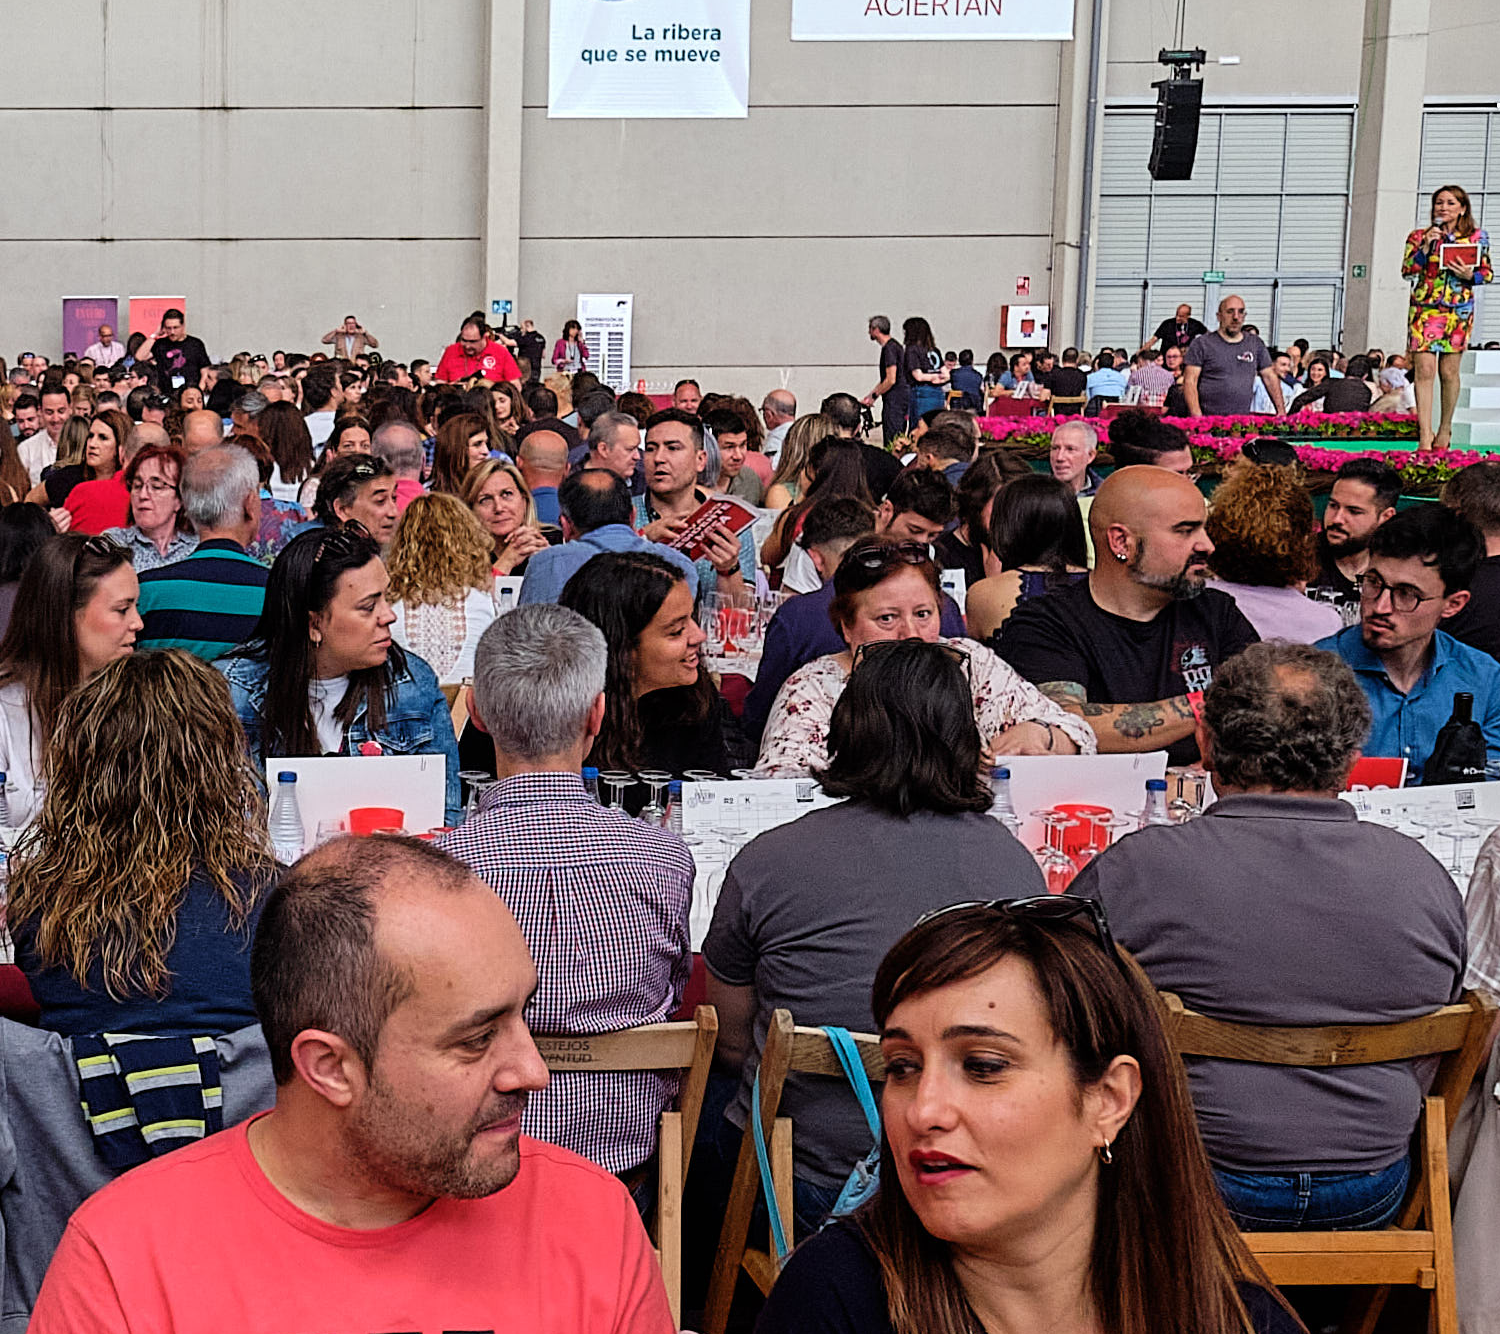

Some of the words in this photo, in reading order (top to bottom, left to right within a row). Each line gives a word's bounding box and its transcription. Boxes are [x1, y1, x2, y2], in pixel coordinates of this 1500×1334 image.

[631, 24, 656, 41] La
[662, 23, 722, 41] ribera
[580, 48, 618, 65] que
[624, 50, 648, 63] se
[653, 50, 721, 64] mueve
